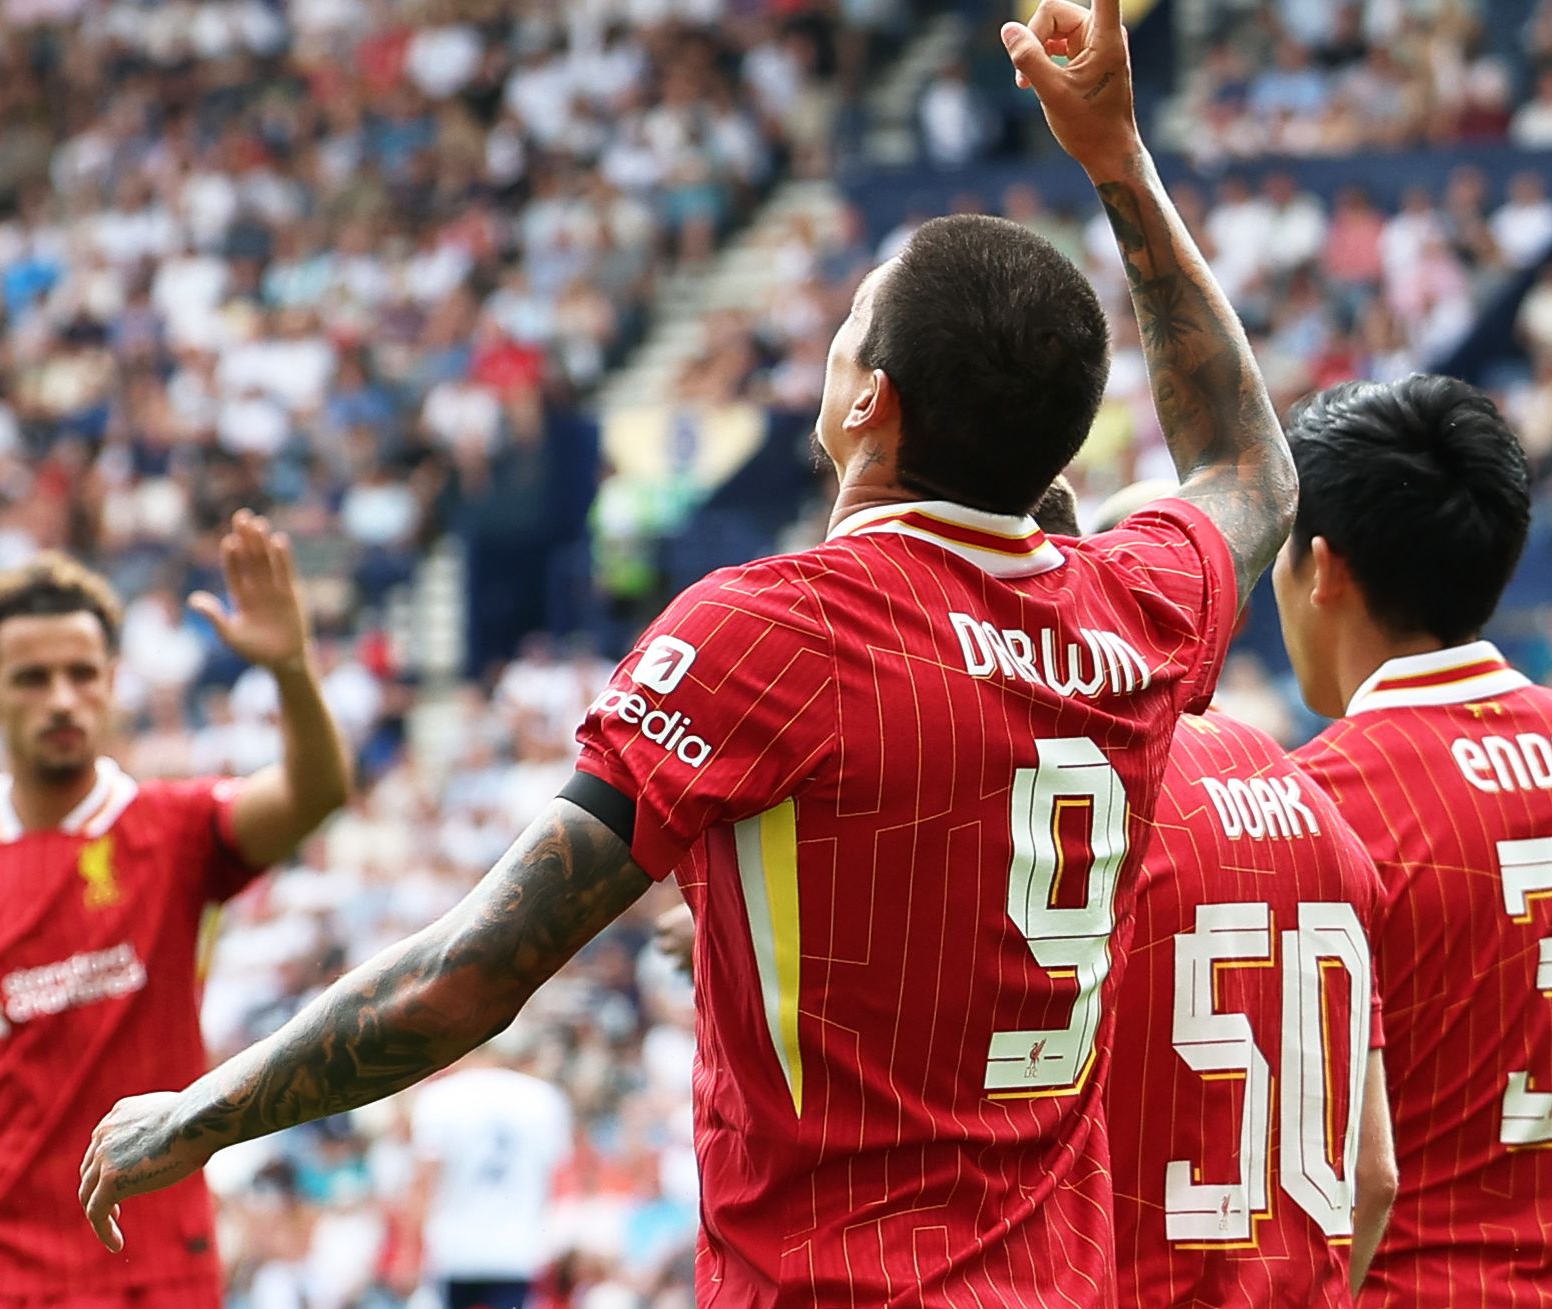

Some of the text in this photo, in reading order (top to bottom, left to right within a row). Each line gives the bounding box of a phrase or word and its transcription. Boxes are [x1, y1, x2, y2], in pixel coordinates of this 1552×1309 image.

[948, 611, 1153, 699] DARWIN
[588, 688, 712, 768] pedia
[1202, 777, 1321, 840] DOAK
[983, 736, 1131, 1099] 9
[1165, 902, 1373, 1250] 50
